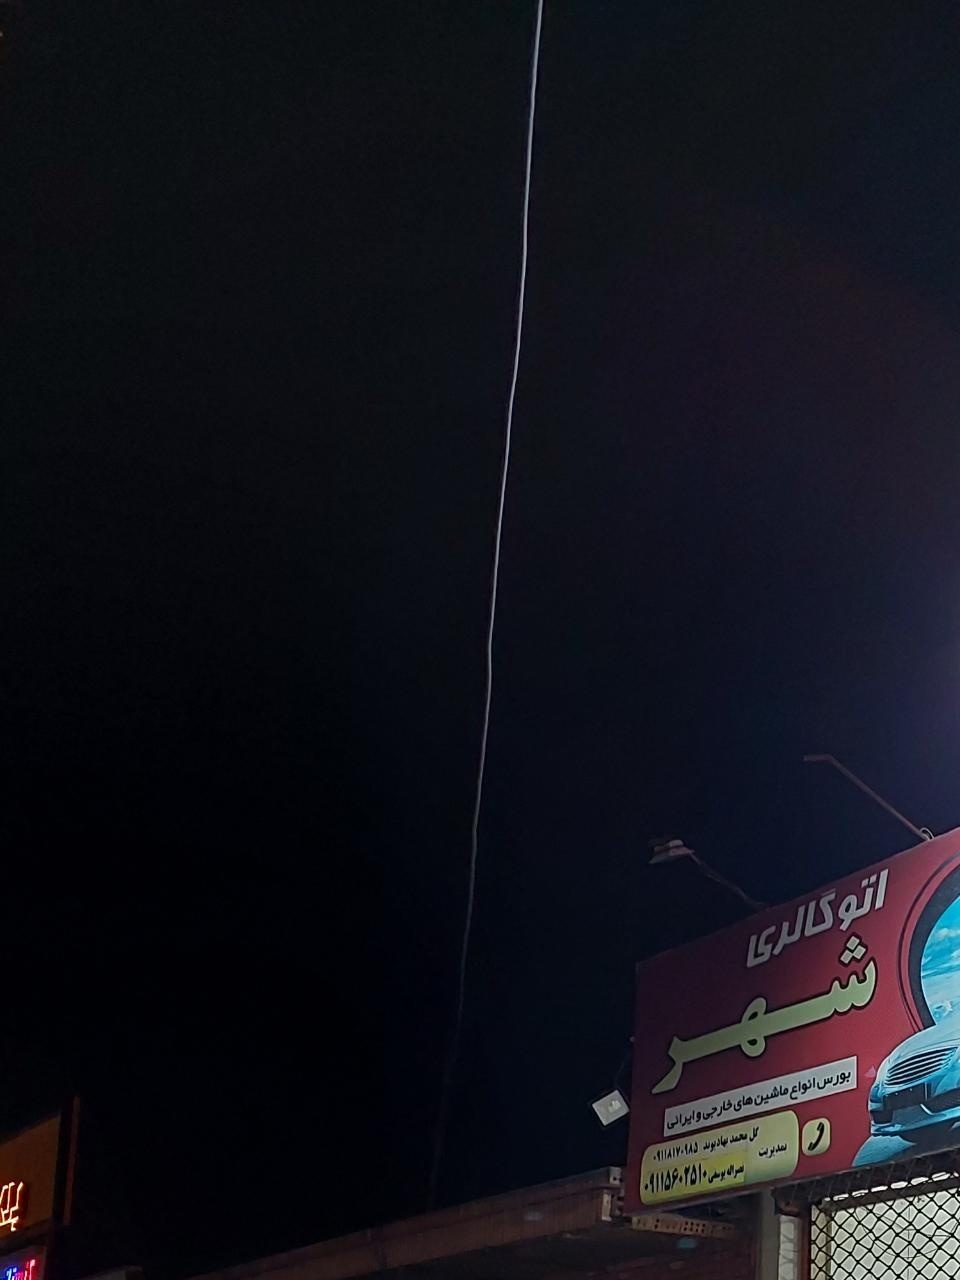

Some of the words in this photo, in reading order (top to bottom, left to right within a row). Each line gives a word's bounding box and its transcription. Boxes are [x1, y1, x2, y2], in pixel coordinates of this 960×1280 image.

[651, 935, 878, 1095] شهر
[789, 1077, 816, 1100] انواع
[817, 1070, 852, 1090] بورس
[732, 1095, 753, 1112] های
[753, 1087, 789, 1107] ماشین
[666, 1110, 696, 1130] ایرانی
[701, 1100, 733, 1121] خارجی
[729, 1133, 748, 1146] محمد
[652, 1141, 699, 1163] ۰۹۱۱۸۱۷۰۹۸۵
[644, 1163, 708, 1193] ۰۹۱۱۵۶۰۲۵۱۰
